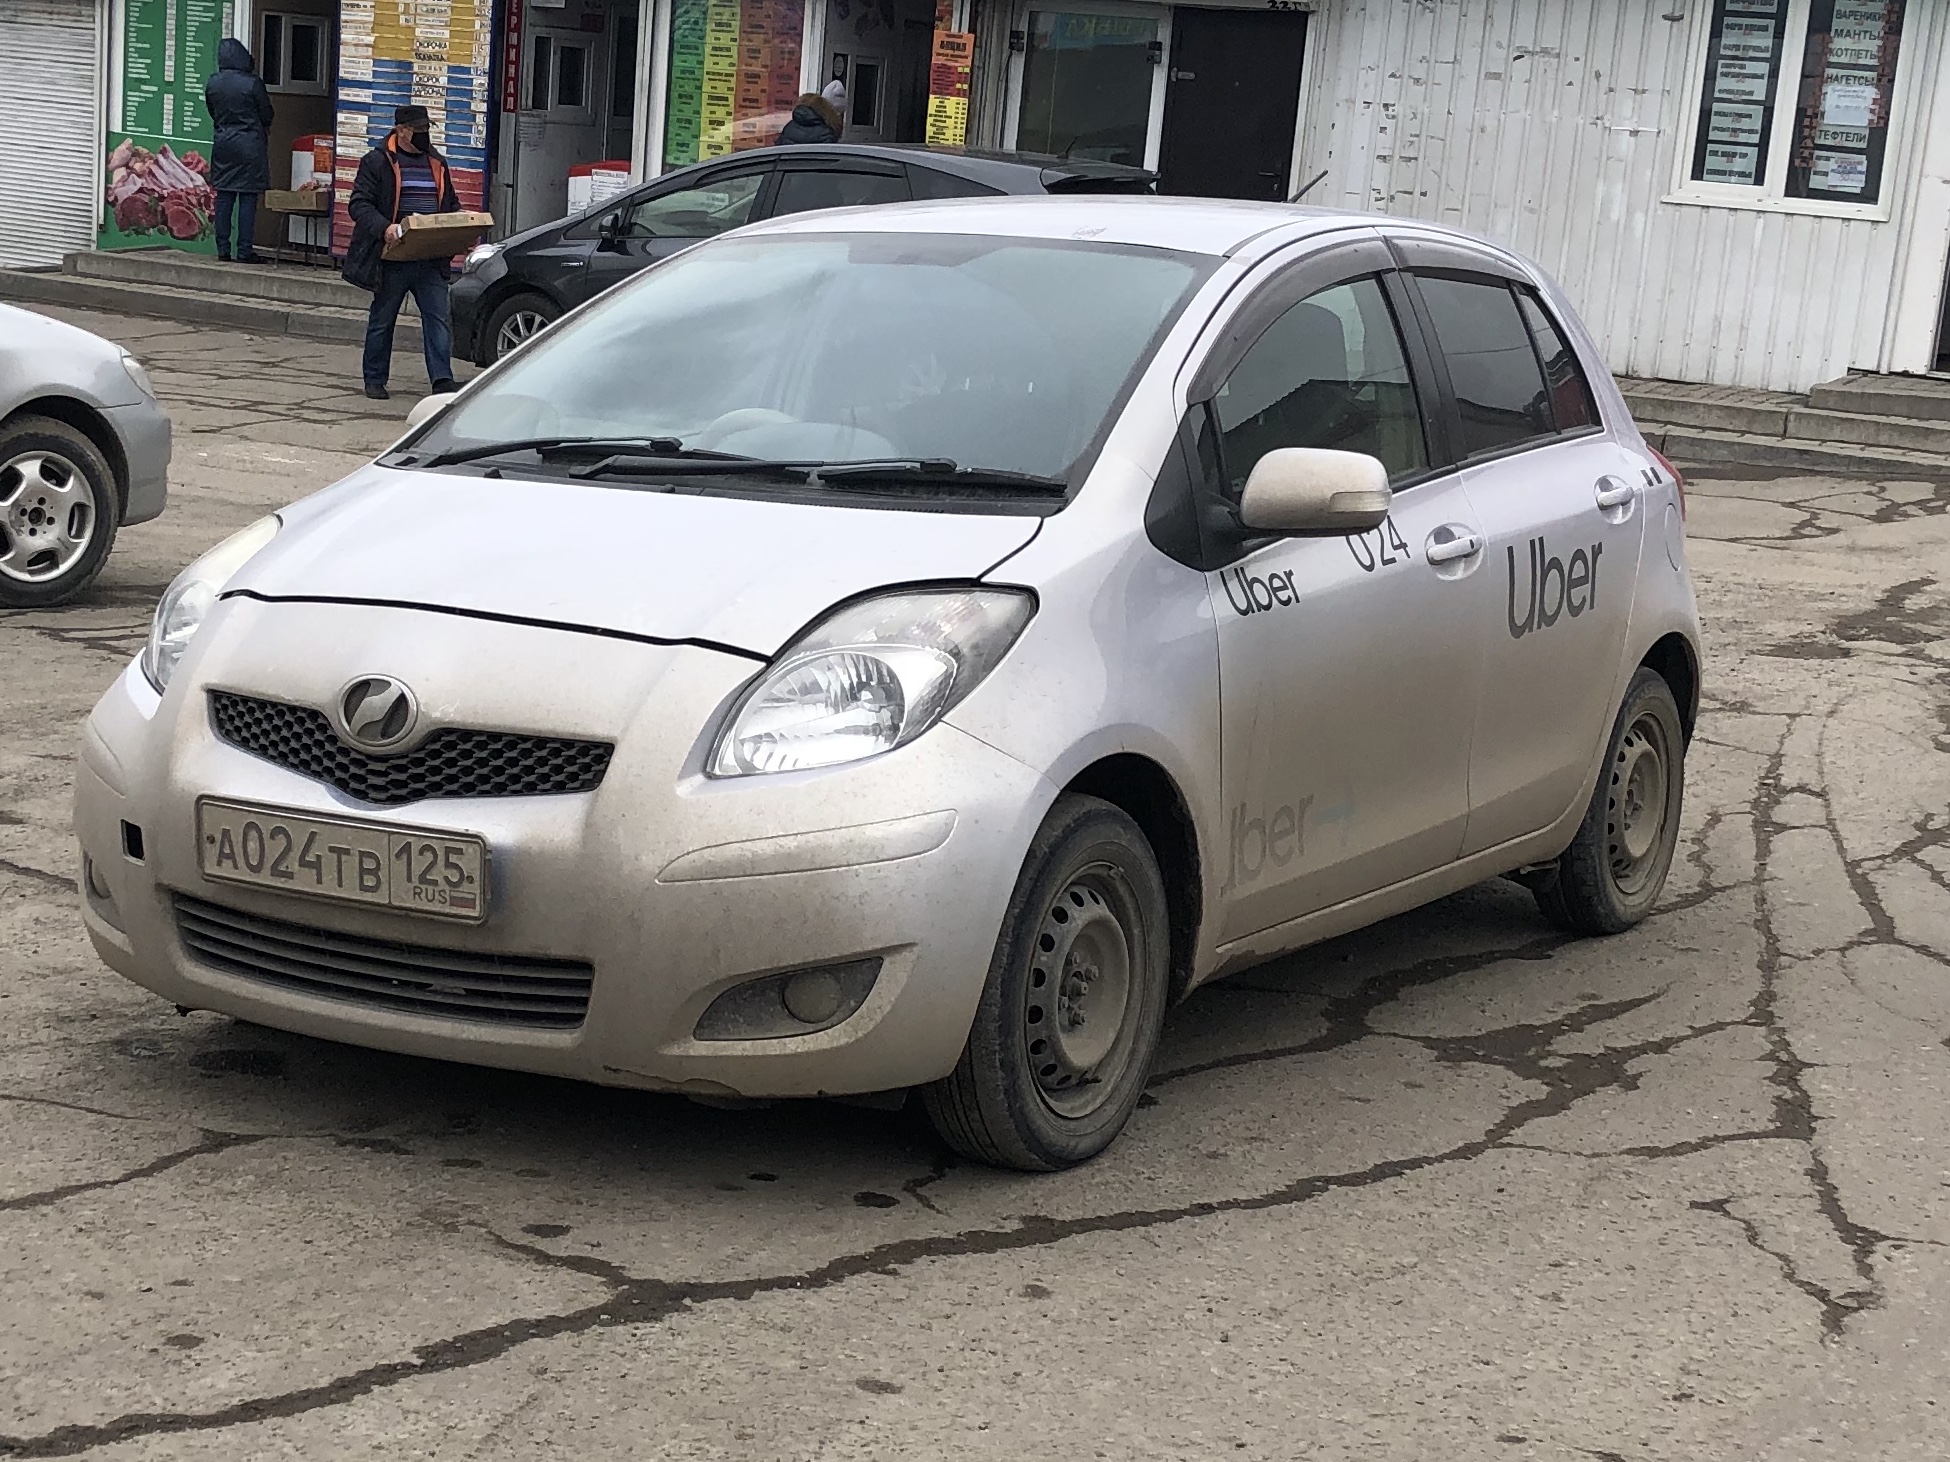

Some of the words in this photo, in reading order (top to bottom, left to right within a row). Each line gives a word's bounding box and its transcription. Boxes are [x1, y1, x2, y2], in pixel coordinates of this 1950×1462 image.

[1835, 9, 1884, 22] ВАРЕНИКИ
[1833, 28, 1882, 41] МАНТЫ
[1818, 129, 1867, 143] ТЕФТЕЛИ
[1219, 566, 1301, 617] Uber
[1507, 535, 1603, 640] Uber
[394, 840, 466, 888] 125
[412, 885, 449, 905] RUS
